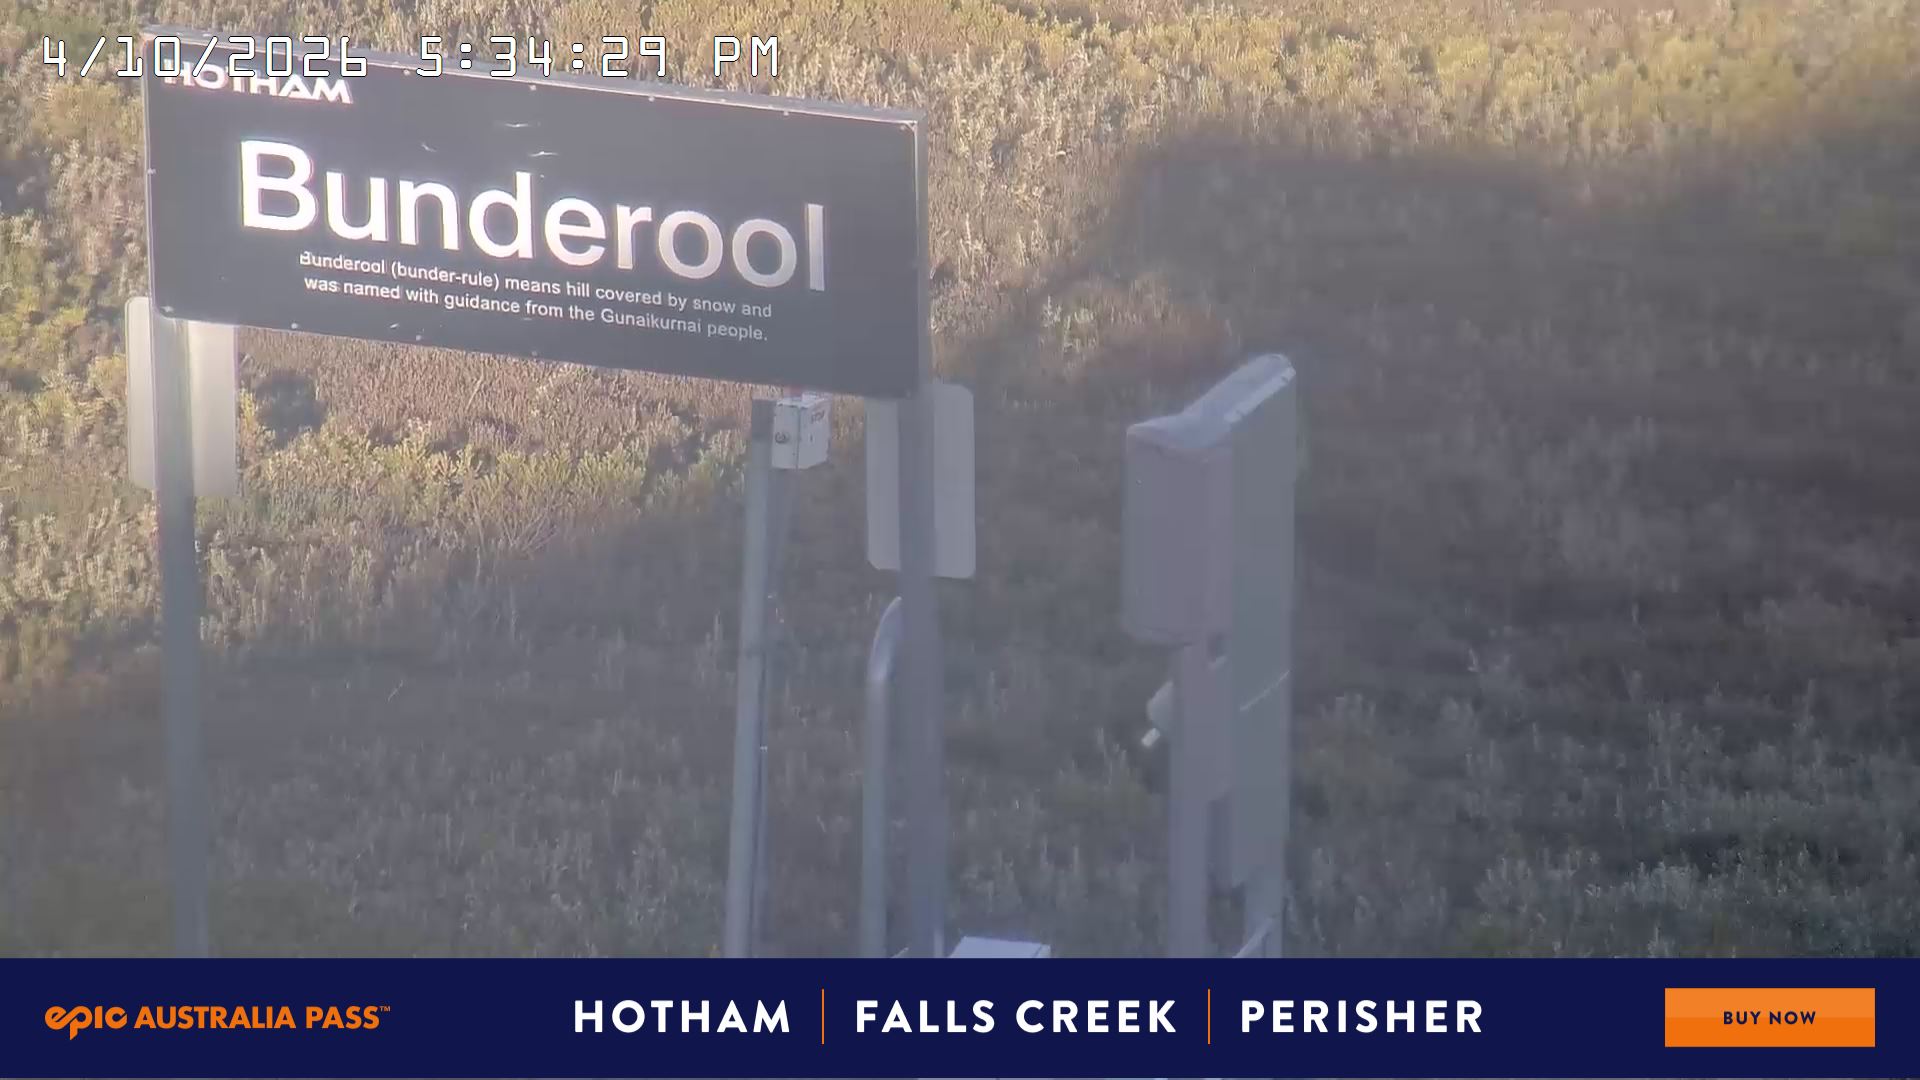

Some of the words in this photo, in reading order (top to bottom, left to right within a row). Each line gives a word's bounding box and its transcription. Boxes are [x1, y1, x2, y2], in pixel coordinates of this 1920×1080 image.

[163, 59, 353, 104] HOTHAM
[239, 137, 826, 292] Bunderool
[299, 251, 386, 275] Bunderool
[391, 260, 500, 291] (bunder-rule)
[505, 276, 561, 296] means
[566, 281, 591, 298] hill
[595, 287, 662, 306] covered
[668, 292, 688, 310] by
[692, 298, 736, 314] snow
[742, 303, 773, 319] and
[304, 277, 339, 293] was
[343, 280, 401, 300] named
[405, 287, 440, 305] with
[444, 292, 521, 314] guidance
[525, 299, 564, 319] from
[569, 304, 596, 322] the
[600, 307, 702, 334] Gunaikurnai
[706, 321, 769, 342] people.
